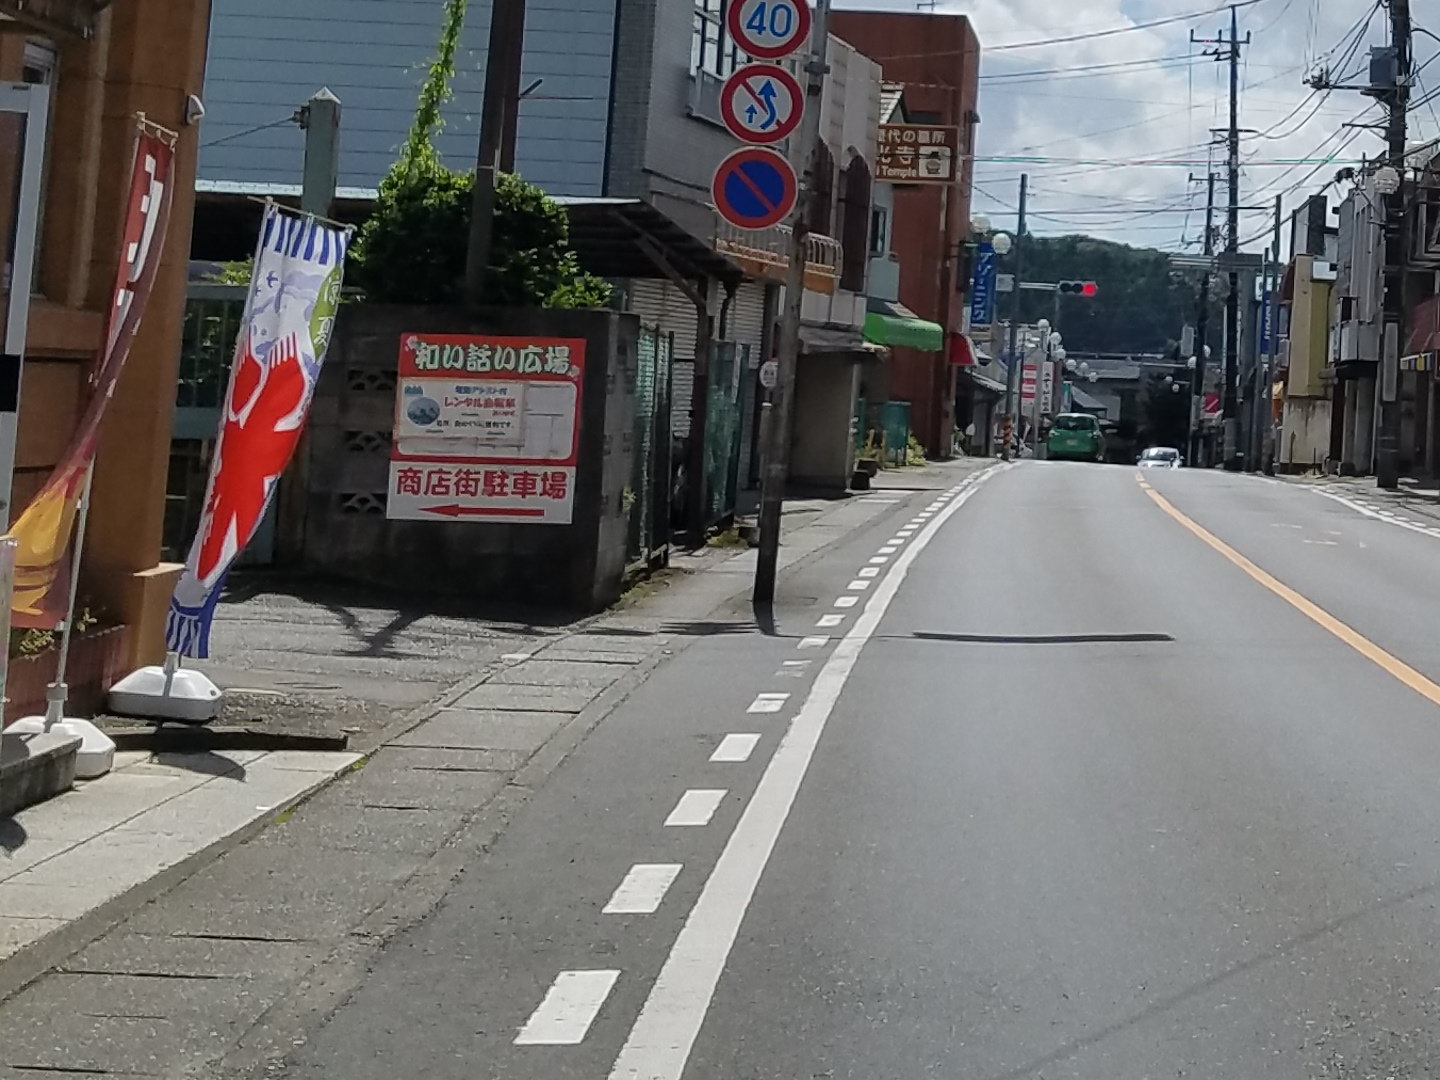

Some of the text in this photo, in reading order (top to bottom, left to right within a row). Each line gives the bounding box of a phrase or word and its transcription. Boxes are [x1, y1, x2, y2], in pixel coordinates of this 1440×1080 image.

[746, 1, 792, 38] 40
[396, 467, 568, 499] 商店街駐車場
